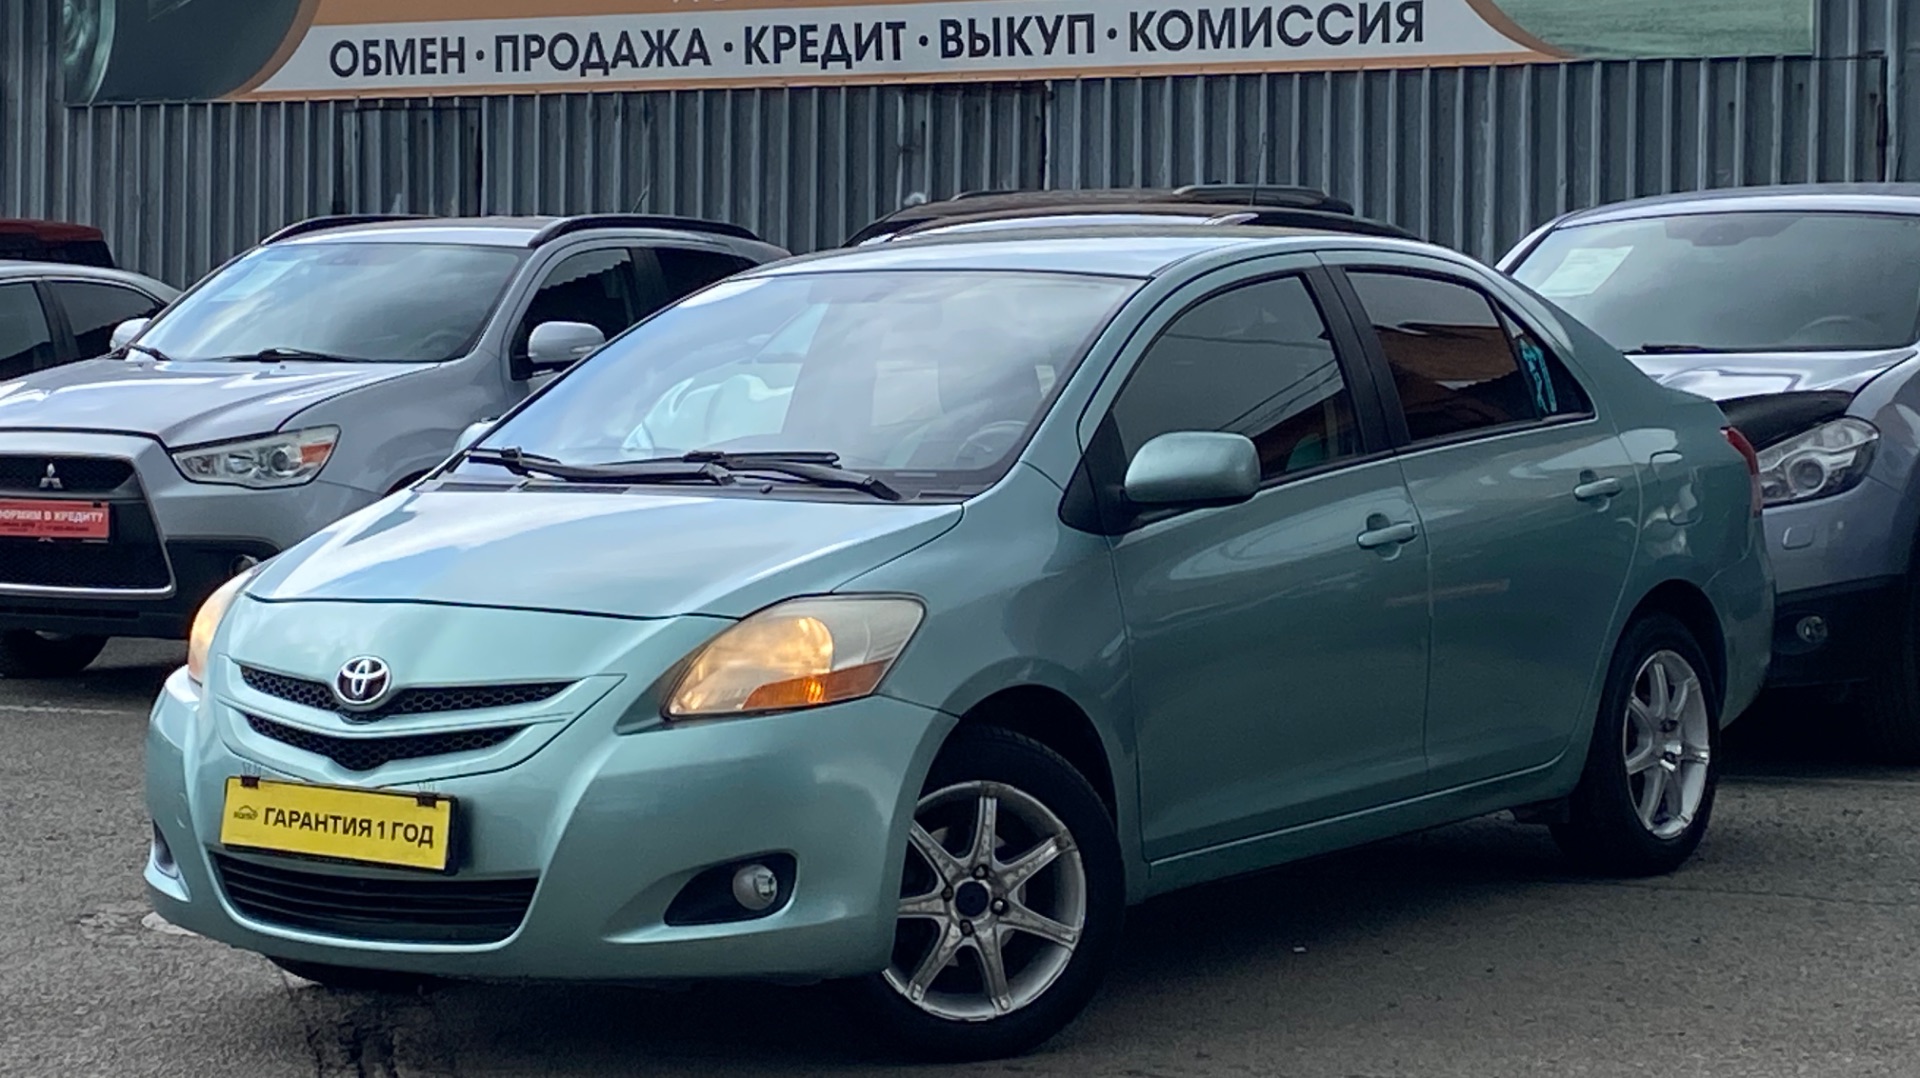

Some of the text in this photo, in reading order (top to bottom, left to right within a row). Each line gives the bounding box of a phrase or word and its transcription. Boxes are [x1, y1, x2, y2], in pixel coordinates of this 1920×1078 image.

[329, 0, 1424, 77] ОБМЕН ПРОДАЖА КРЕДИТ ВЫКУП КОМИССИЯ
[263, 807, 434, 849] ГАРАНТИЯ 1 ГОД
